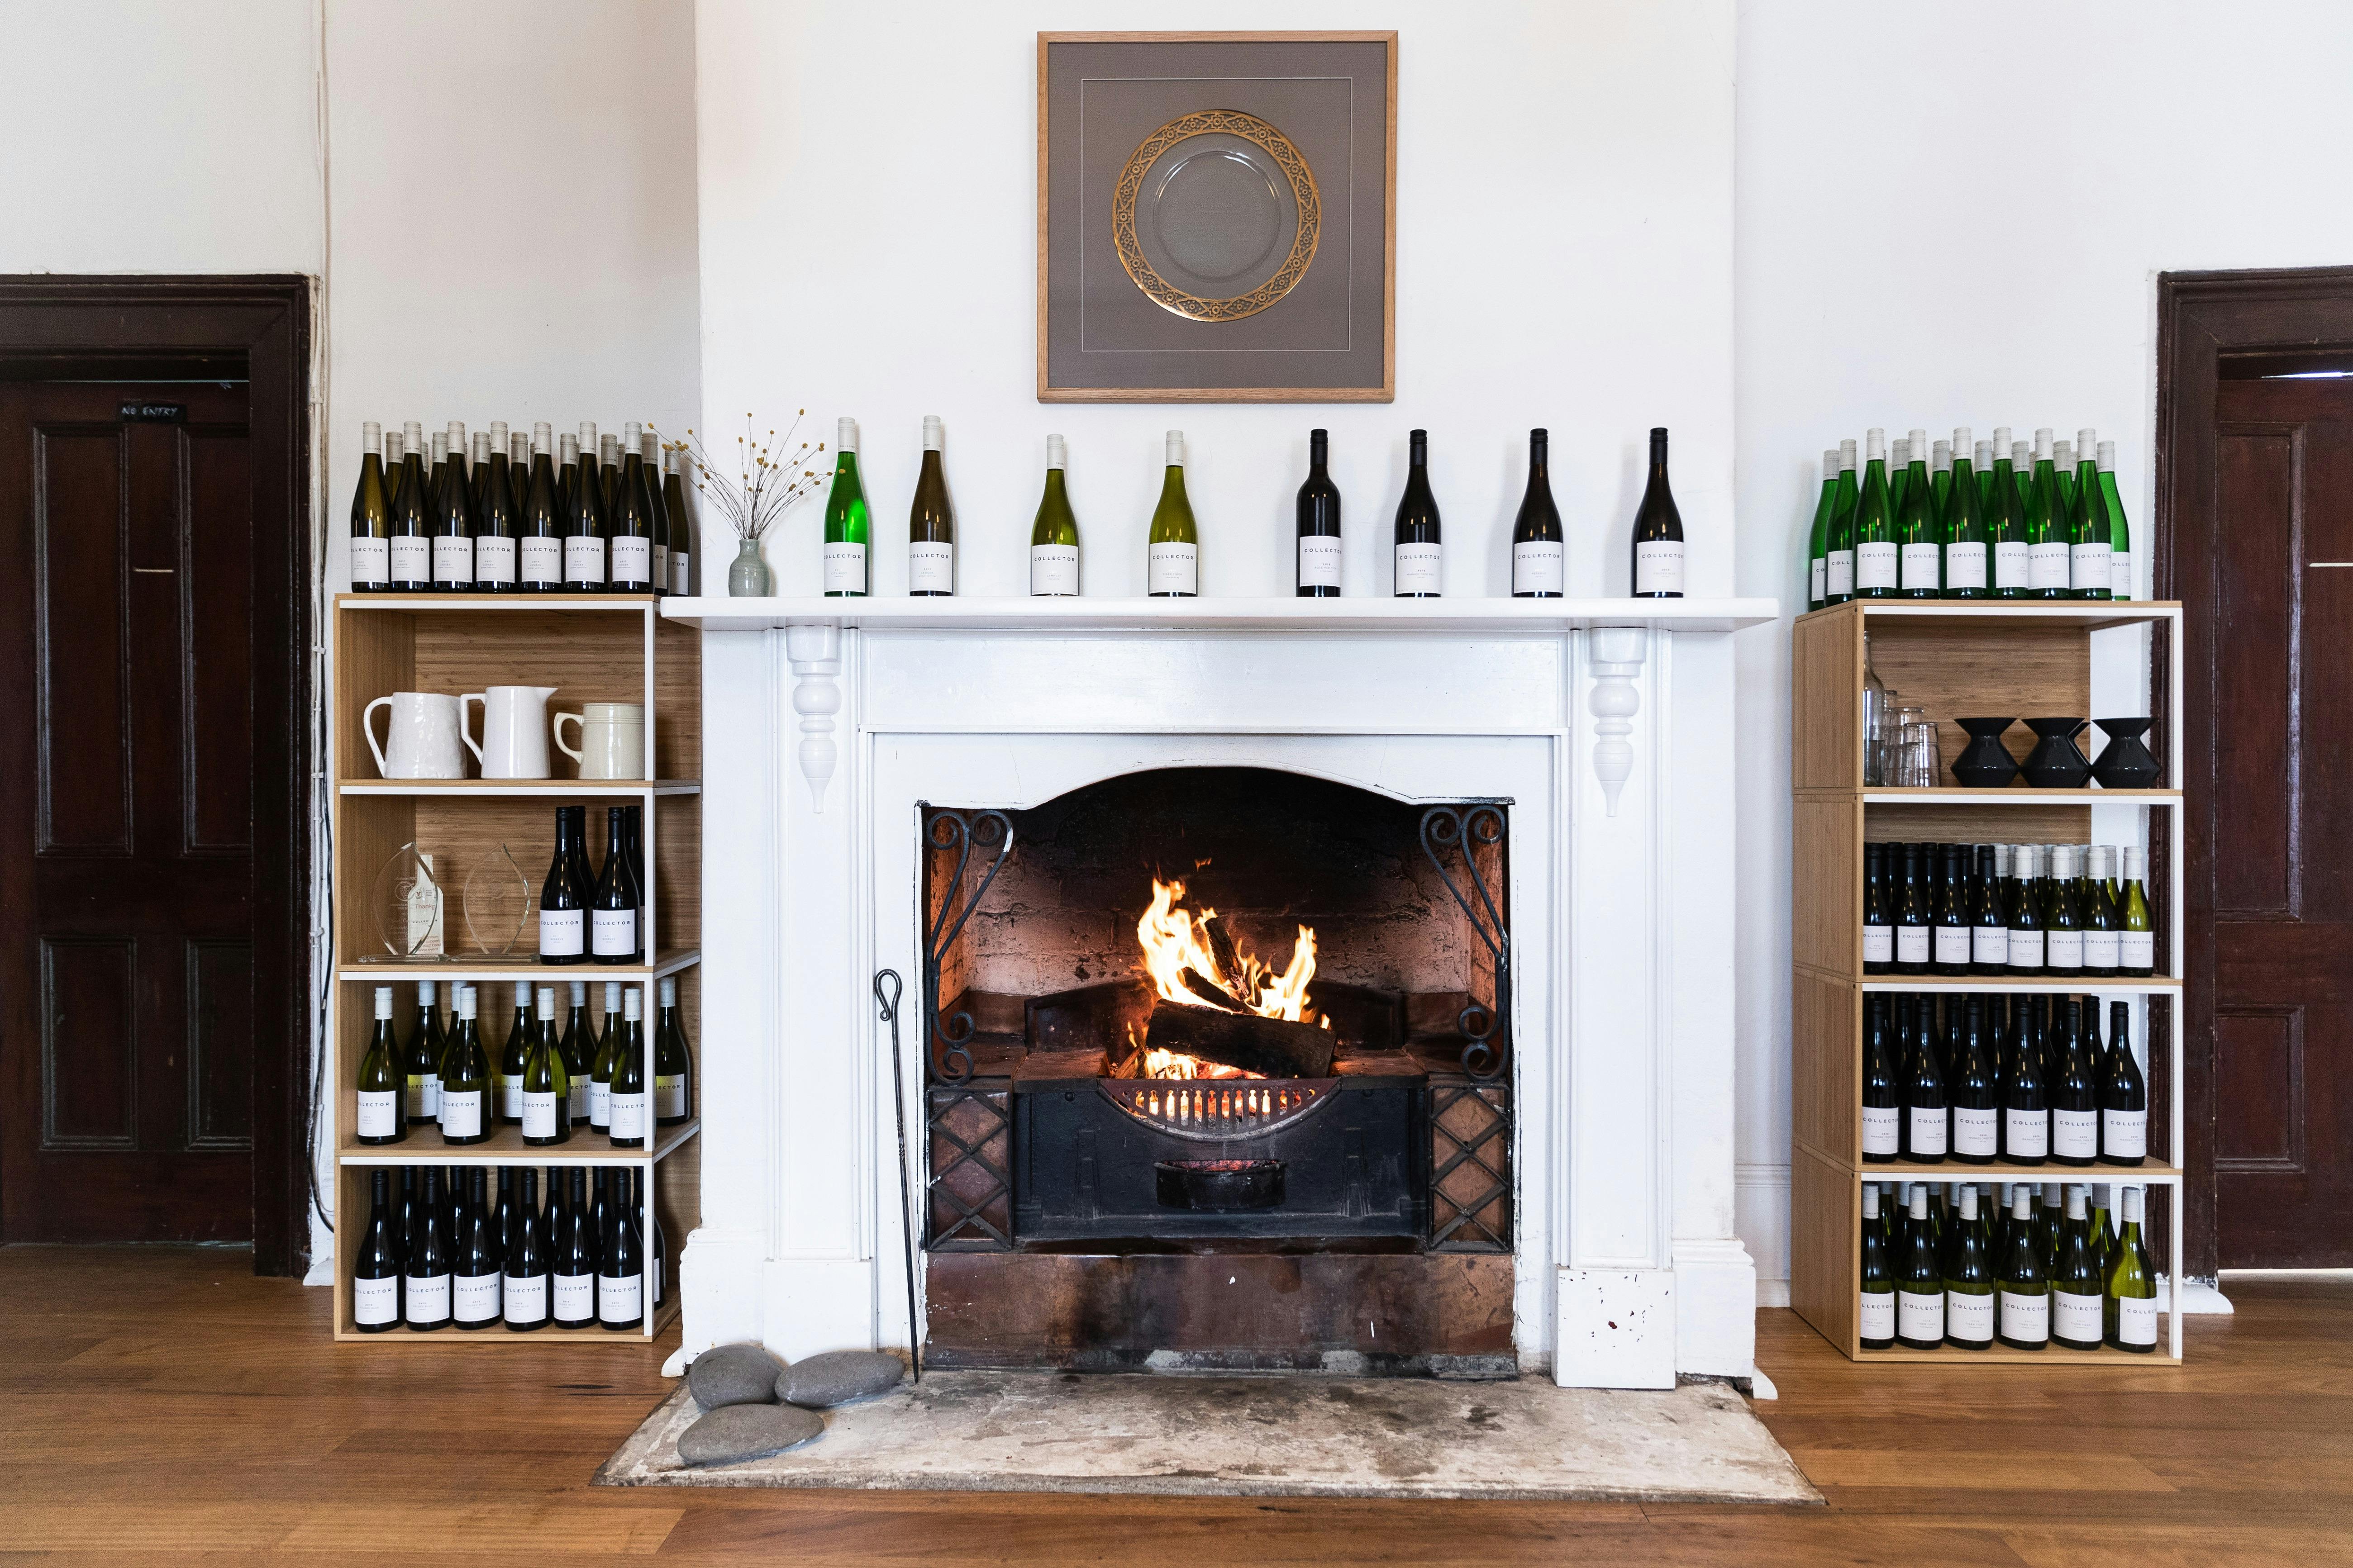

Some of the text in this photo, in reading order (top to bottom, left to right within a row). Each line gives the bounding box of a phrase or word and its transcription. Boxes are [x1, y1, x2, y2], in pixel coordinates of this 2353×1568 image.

[143, 406, 177, 416] ENTRY
[457, 1283, 497, 1292] COLLECTOR
[2058, 1302, 2100, 1311] COLLECTOR
